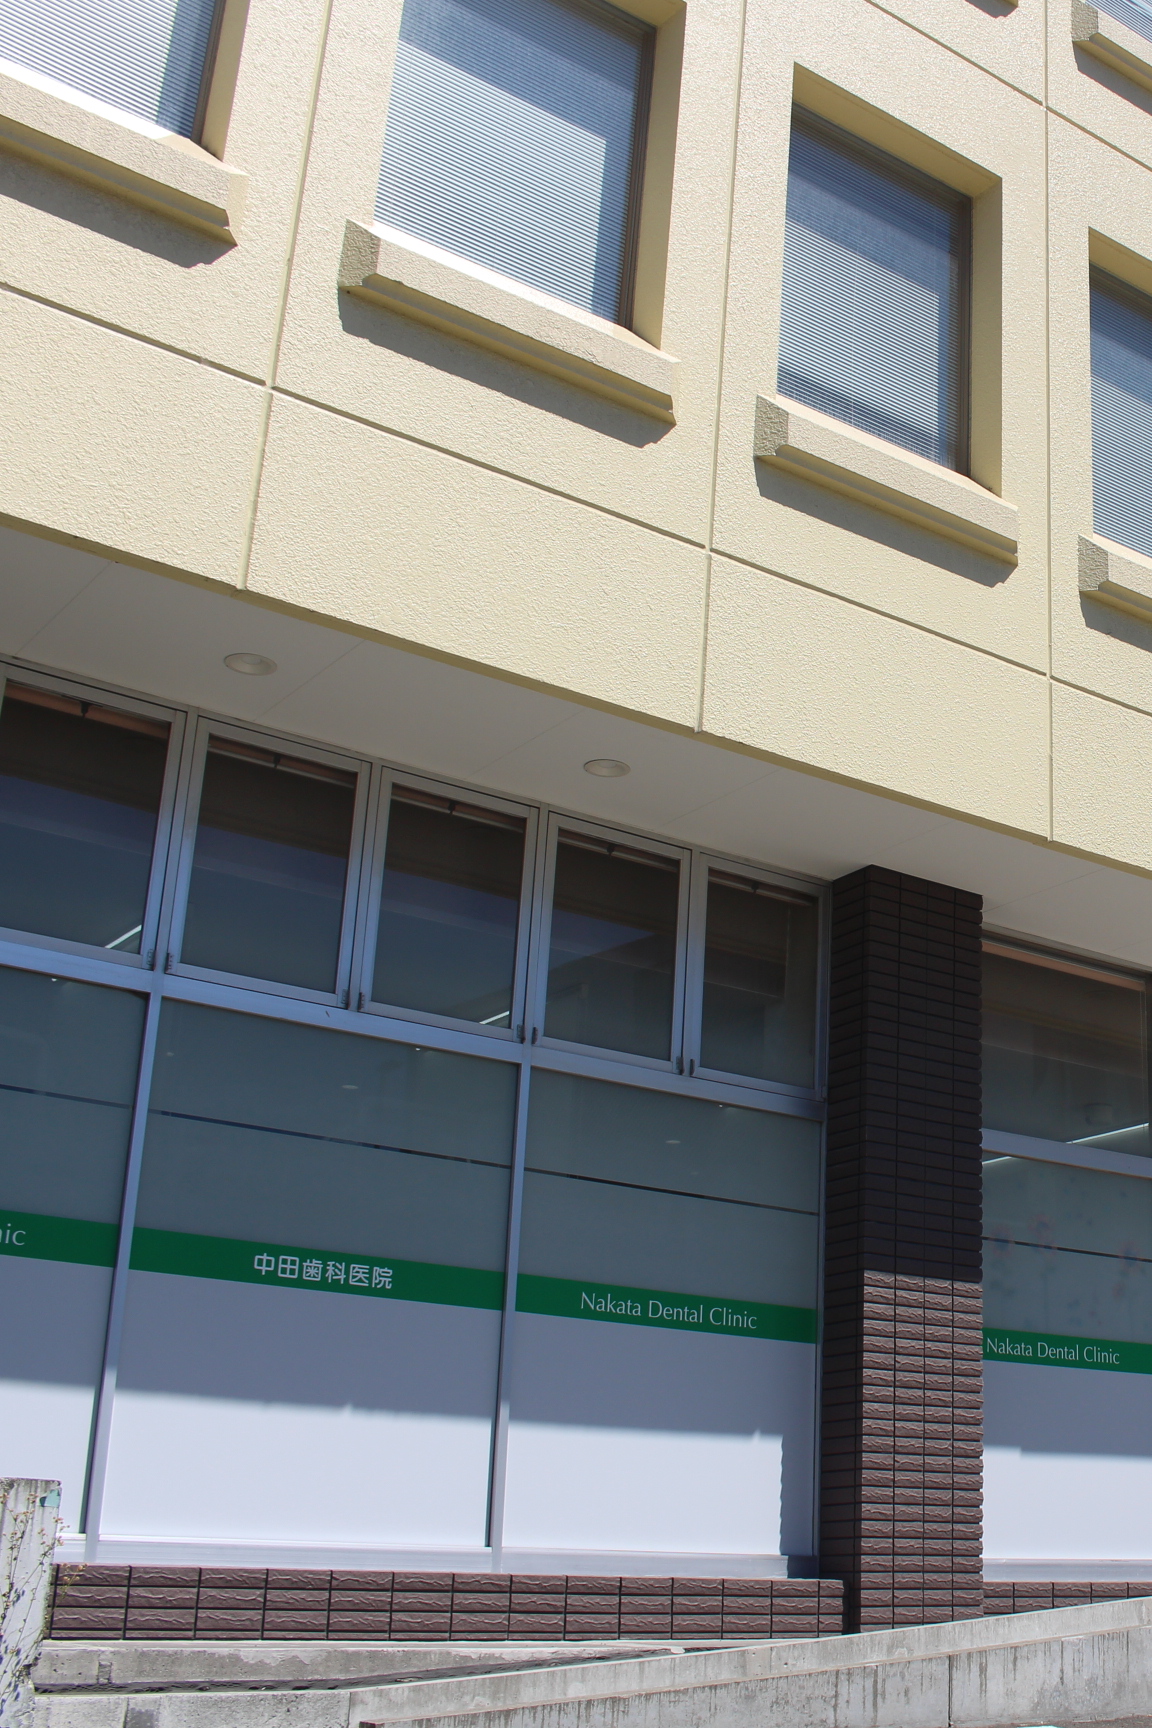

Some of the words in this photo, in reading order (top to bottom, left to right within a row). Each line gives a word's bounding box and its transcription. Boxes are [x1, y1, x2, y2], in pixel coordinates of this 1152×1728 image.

[254, 1252, 393, 1289] 中田歯科医院
[580, 1291, 642, 1316] Nakata
[648, 1300, 703, 1323] Dental
[709, 1307, 757, 1329] Clinic
[986, 1337, 1033, 1357] Nakata
[1037, 1342, 1080, 1361] Dental
[1083, 1346, 1120, 1365] Clinic
